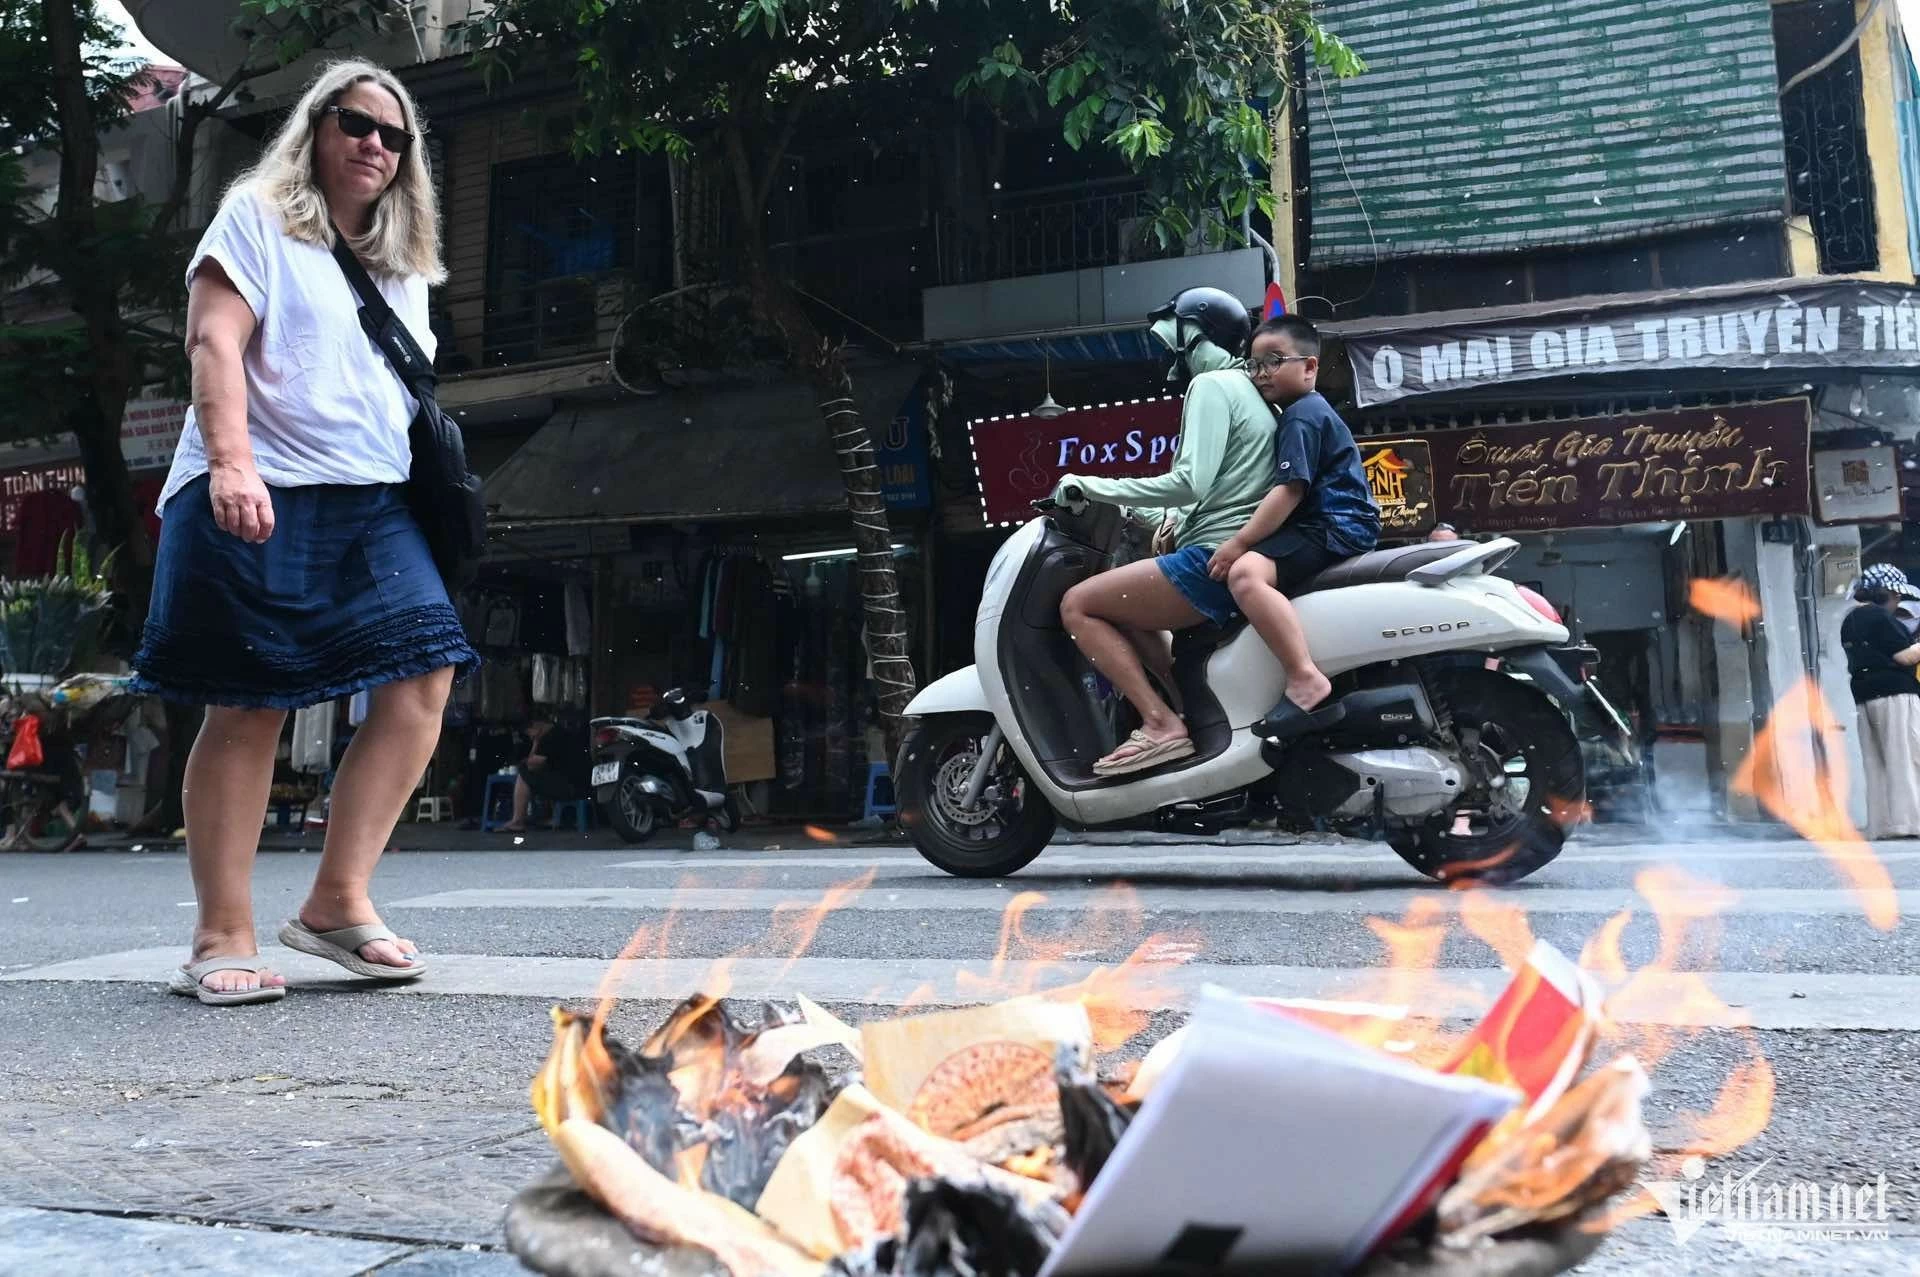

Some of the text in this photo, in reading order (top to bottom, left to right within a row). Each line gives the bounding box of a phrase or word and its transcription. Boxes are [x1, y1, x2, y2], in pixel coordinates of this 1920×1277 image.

[1372, 291, 1920, 390] Ô MAI GIA TRUYỀN TIẾ
[1450, 463, 1577, 511] Tiến
